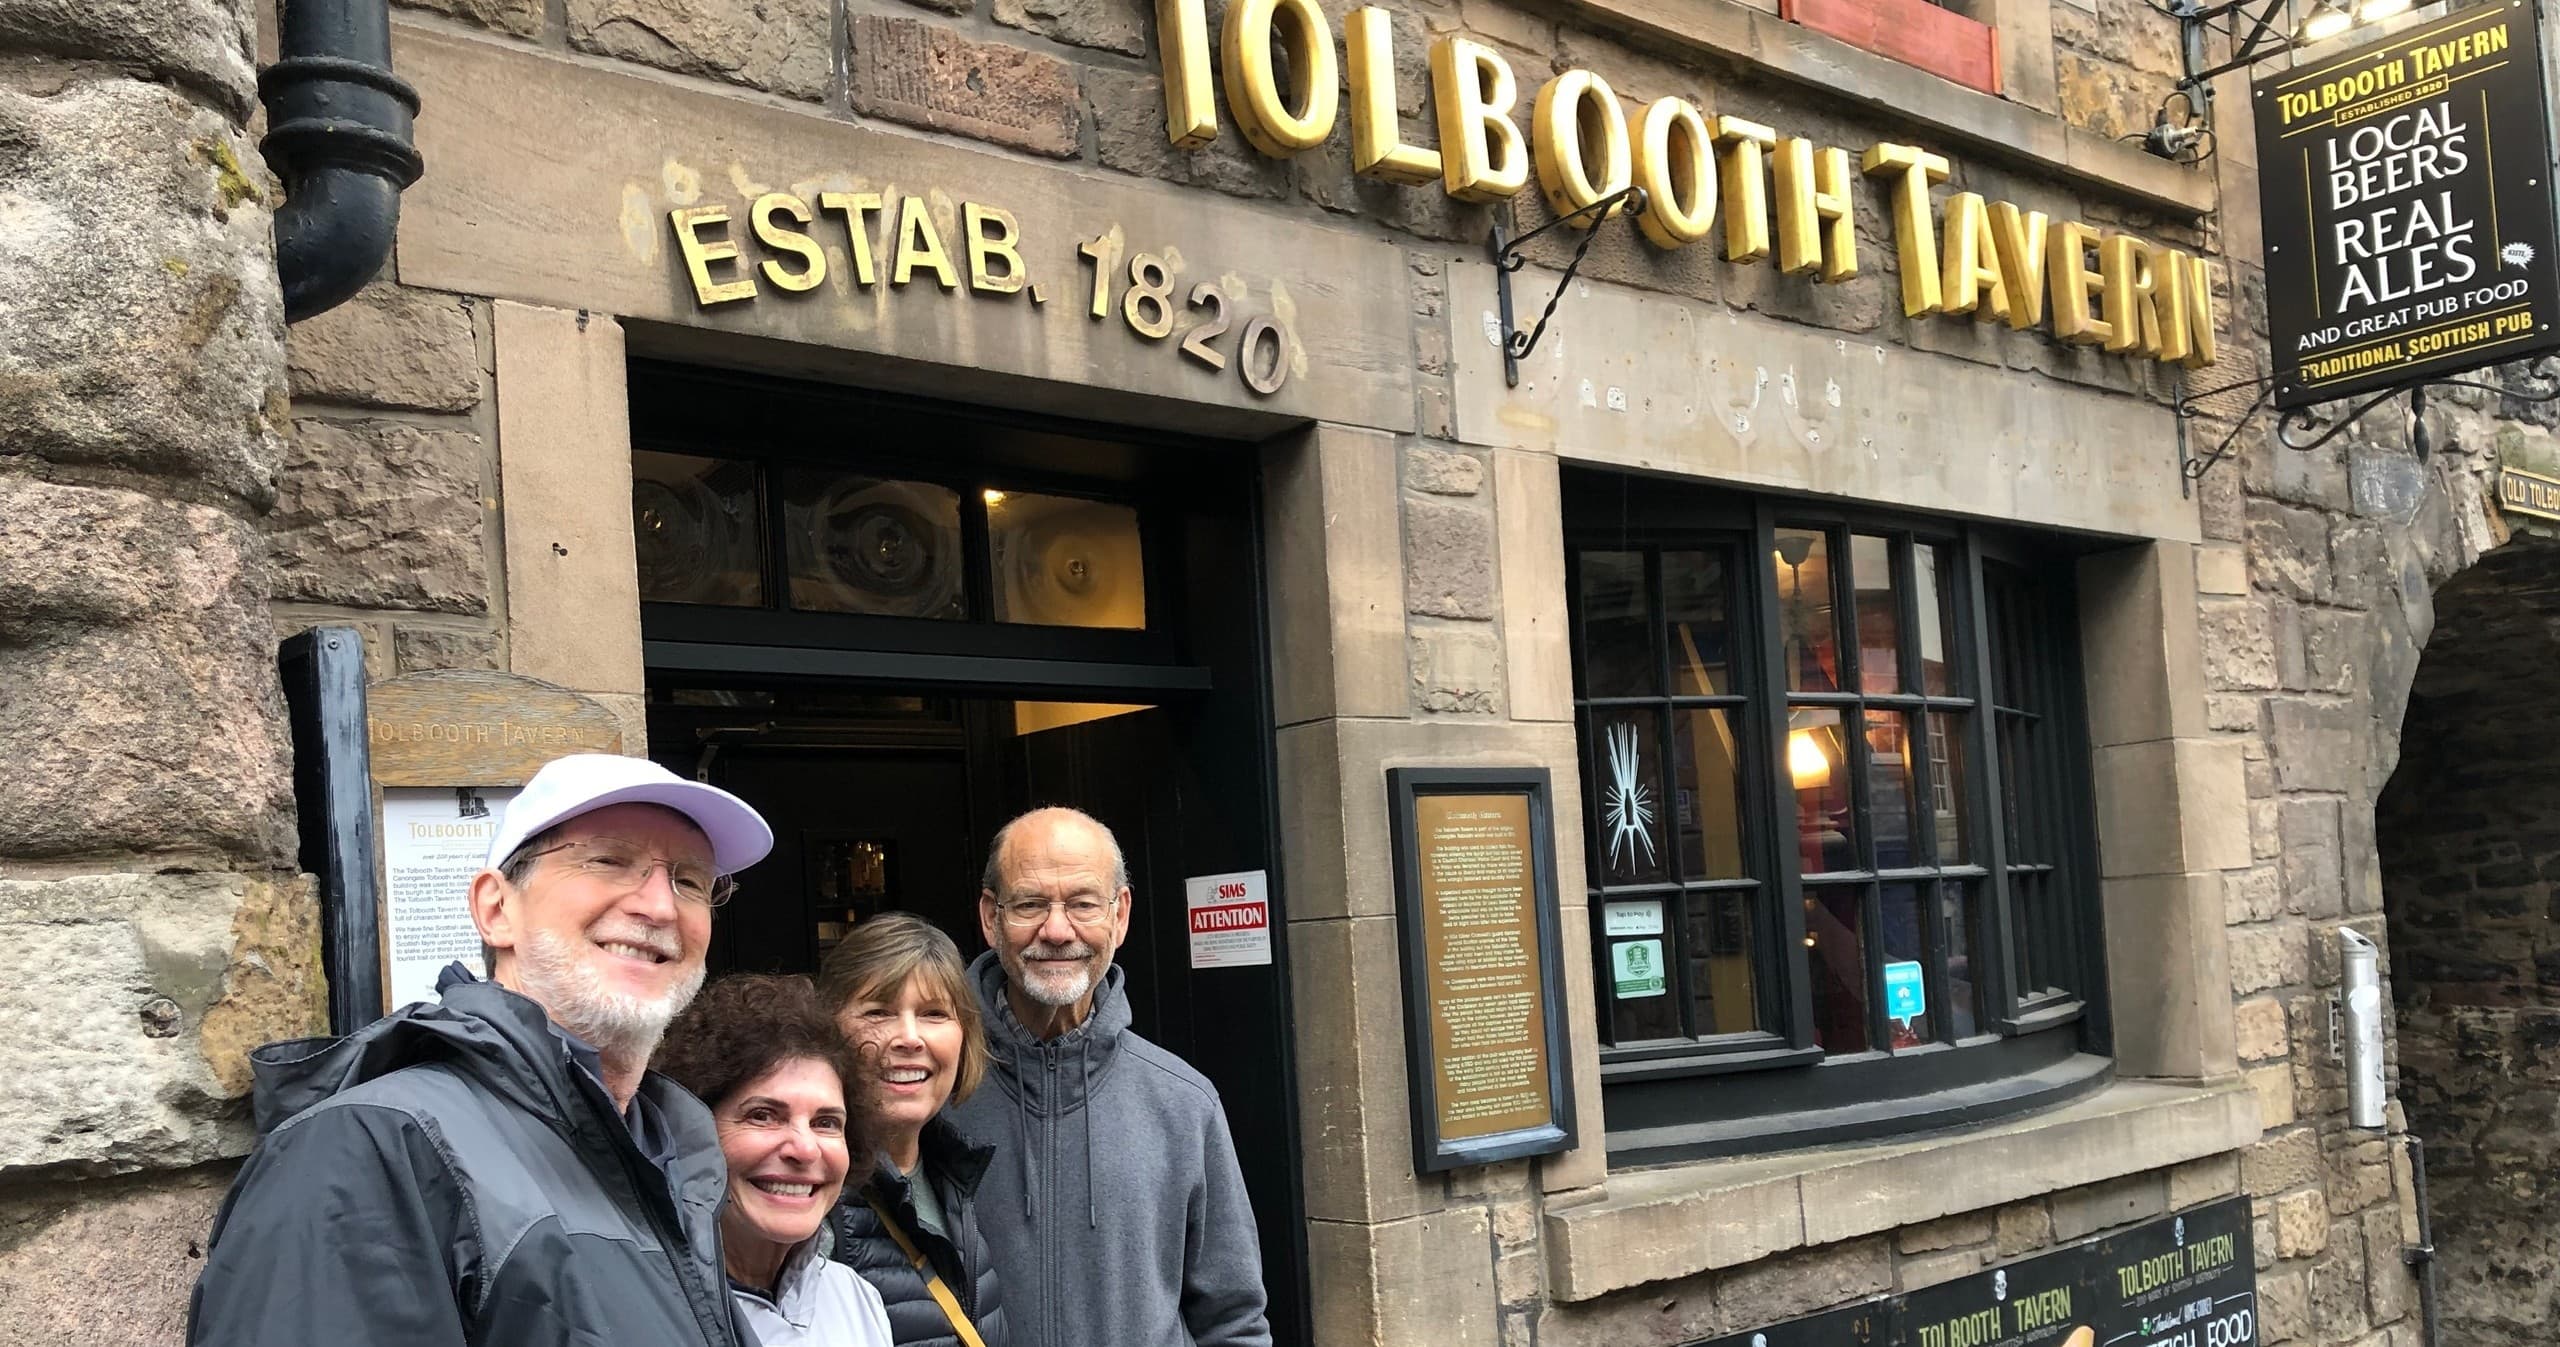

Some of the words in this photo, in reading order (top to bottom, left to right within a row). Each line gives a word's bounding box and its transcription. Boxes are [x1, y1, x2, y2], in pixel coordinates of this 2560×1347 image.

[2277, 60, 2405, 125] TOLBOOTH
[2408, 23, 2508, 80] TAVERN
[2340, 91, 2412, 121] ESTABLISHED
[2415, 80, 2443, 98] 1820
[2327, 102, 2467, 172] LOCAL
[2330, 135, 2469, 210] BEERS
[1861, 140, 2217, 370] TAVERN
[2335, 191, 2475, 265] REAL
[669, 191, 1048, 307] ESTAB.
[1078, 235, 1290, 396] 1820
[2337, 234, 2477, 314] ALES
[2298, 326, 2341, 351] AND
[2345, 309, 2410, 342] GREAT
[2416, 297, 2458, 323] PUB
[2464, 279, 2529, 312] FOOD
[2408, 320, 2491, 356] SCOTTISH
[2496, 311, 2533, 336] PUB
[2506, 477, 2525, 503] OLD
[2529, 482, 2560, 511] TOLBO
[367, 713, 490, 745] TOLBOOTH
[500, 719, 584, 746] TAVERN
[408, 822, 481, 839] TOLBOOTH
[1194, 906, 1263, 929] ATTENTION
[1218, 883, 1246, 899] SIMS
[2117, 1249, 2184, 1299] TOLBOOTH
[2187, 1232, 2234, 1274] TAVERN
[2013, 1285, 2072, 1333] TAVERN
[2207, 1309, 2252, 1347] FOOD
